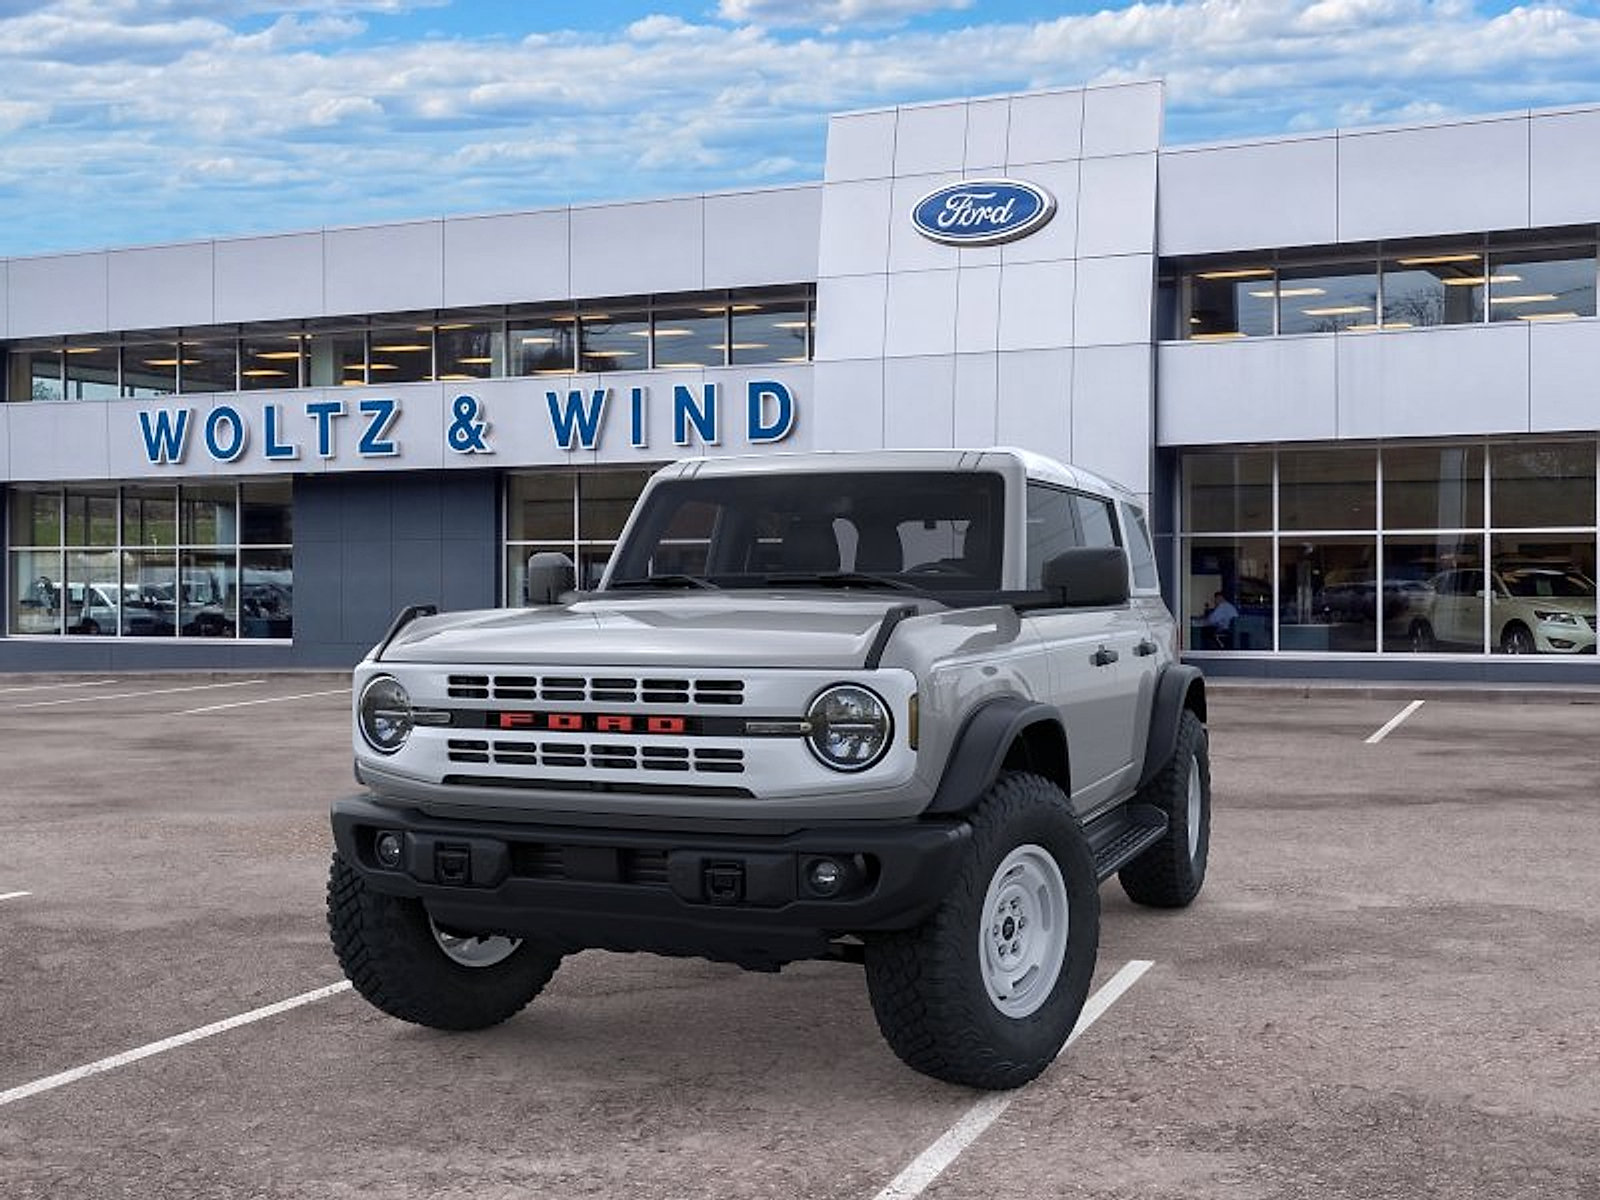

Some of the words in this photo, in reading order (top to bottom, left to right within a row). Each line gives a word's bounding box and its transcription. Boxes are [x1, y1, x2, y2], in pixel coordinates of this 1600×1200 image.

[938, 191, 1015, 228] Ford
[138, 399, 402, 464] WOLTZ
[447, 395, 494, 454] &
[546, 380, 796, 449] WIND
[500, 712, 685, 733] FORD
